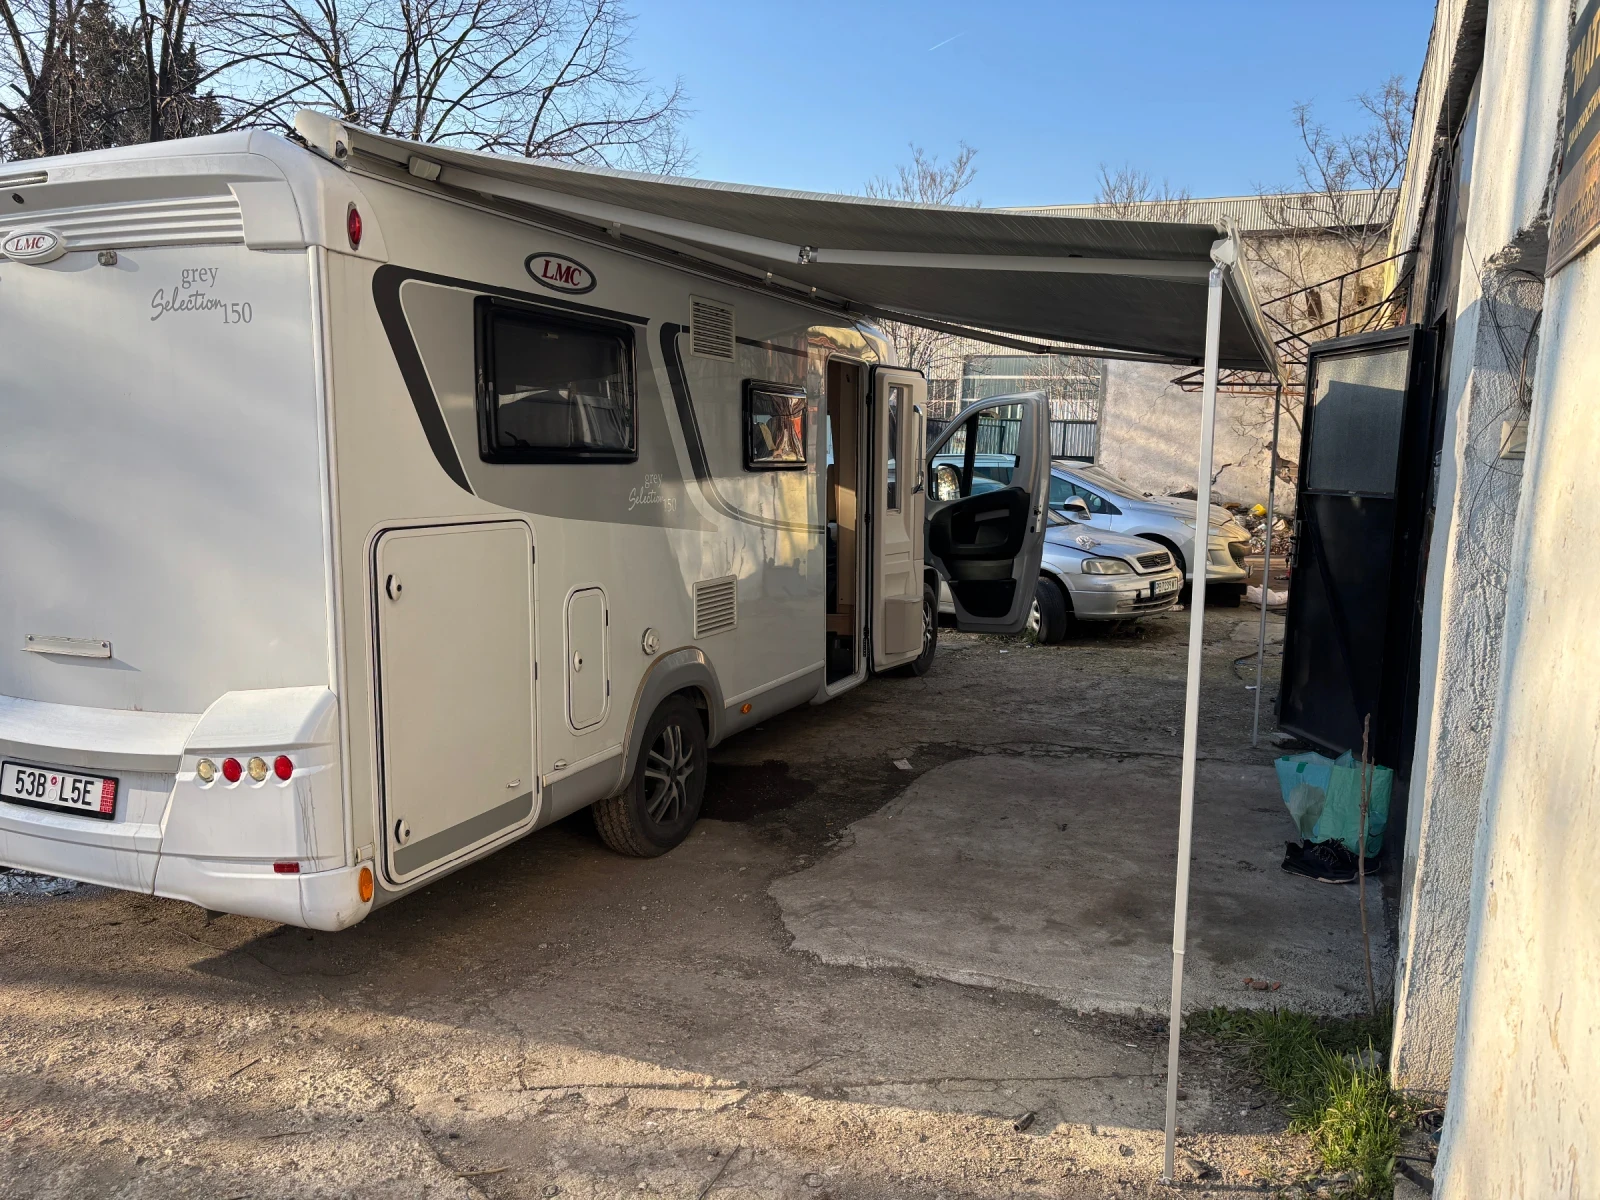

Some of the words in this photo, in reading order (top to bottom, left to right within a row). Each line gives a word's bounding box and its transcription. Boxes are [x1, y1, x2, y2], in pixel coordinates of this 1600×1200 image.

[14, 236, 45, 251] LMC
[181, 267, 219, 290] grey
[541, 259, 582, 286] LMC
[150, 287, 224, 321] Selection
[222, 302, 252, 324] 150
[644, 473, 663, 489] grey
[628, 486, 664, 511] Selection
[663, 498, 677, 512] 150
[15, 769, 47, 798] 53B
[58, 777, 94, 806] L5E
